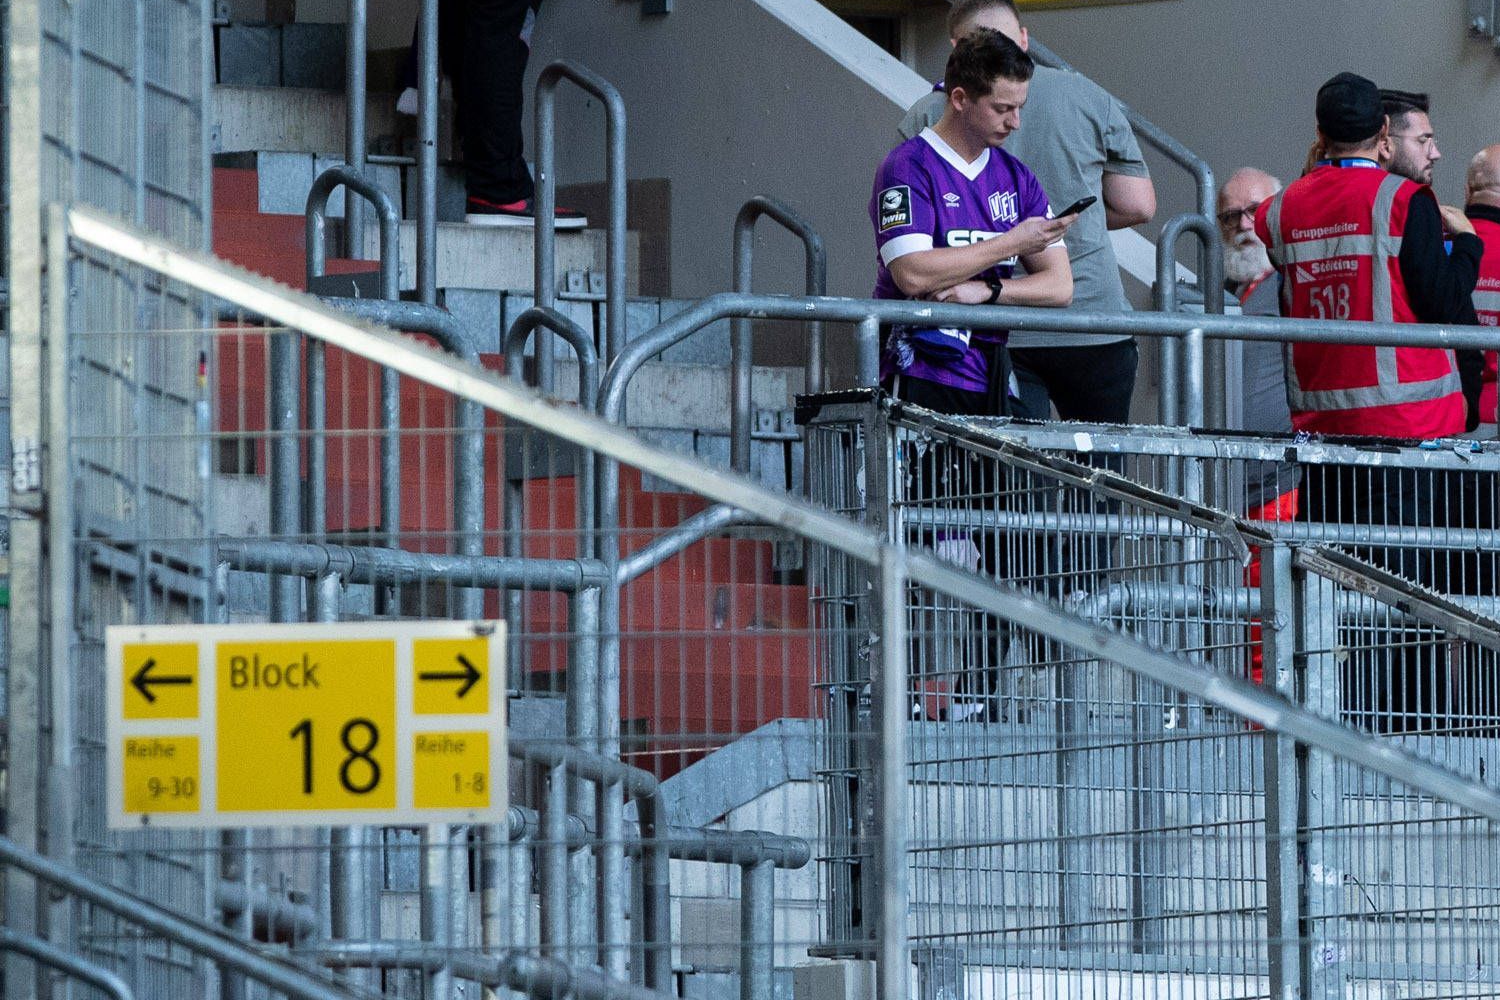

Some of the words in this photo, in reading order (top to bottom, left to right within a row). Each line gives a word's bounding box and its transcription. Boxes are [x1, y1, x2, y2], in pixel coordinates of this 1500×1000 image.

[882, 211, 906, 226] bwin
[1291, 223, 1360, 239] Gruppenleiter
[1309, 283, 1351, 320] 518
[230, 653, 320, 689] Block
[126, 738, 176, 757] Reihe
[416, 733, 465, 751] Reihe
[290, 717, 381, 795] 18
[453, 771, 485, 794] 1-8
